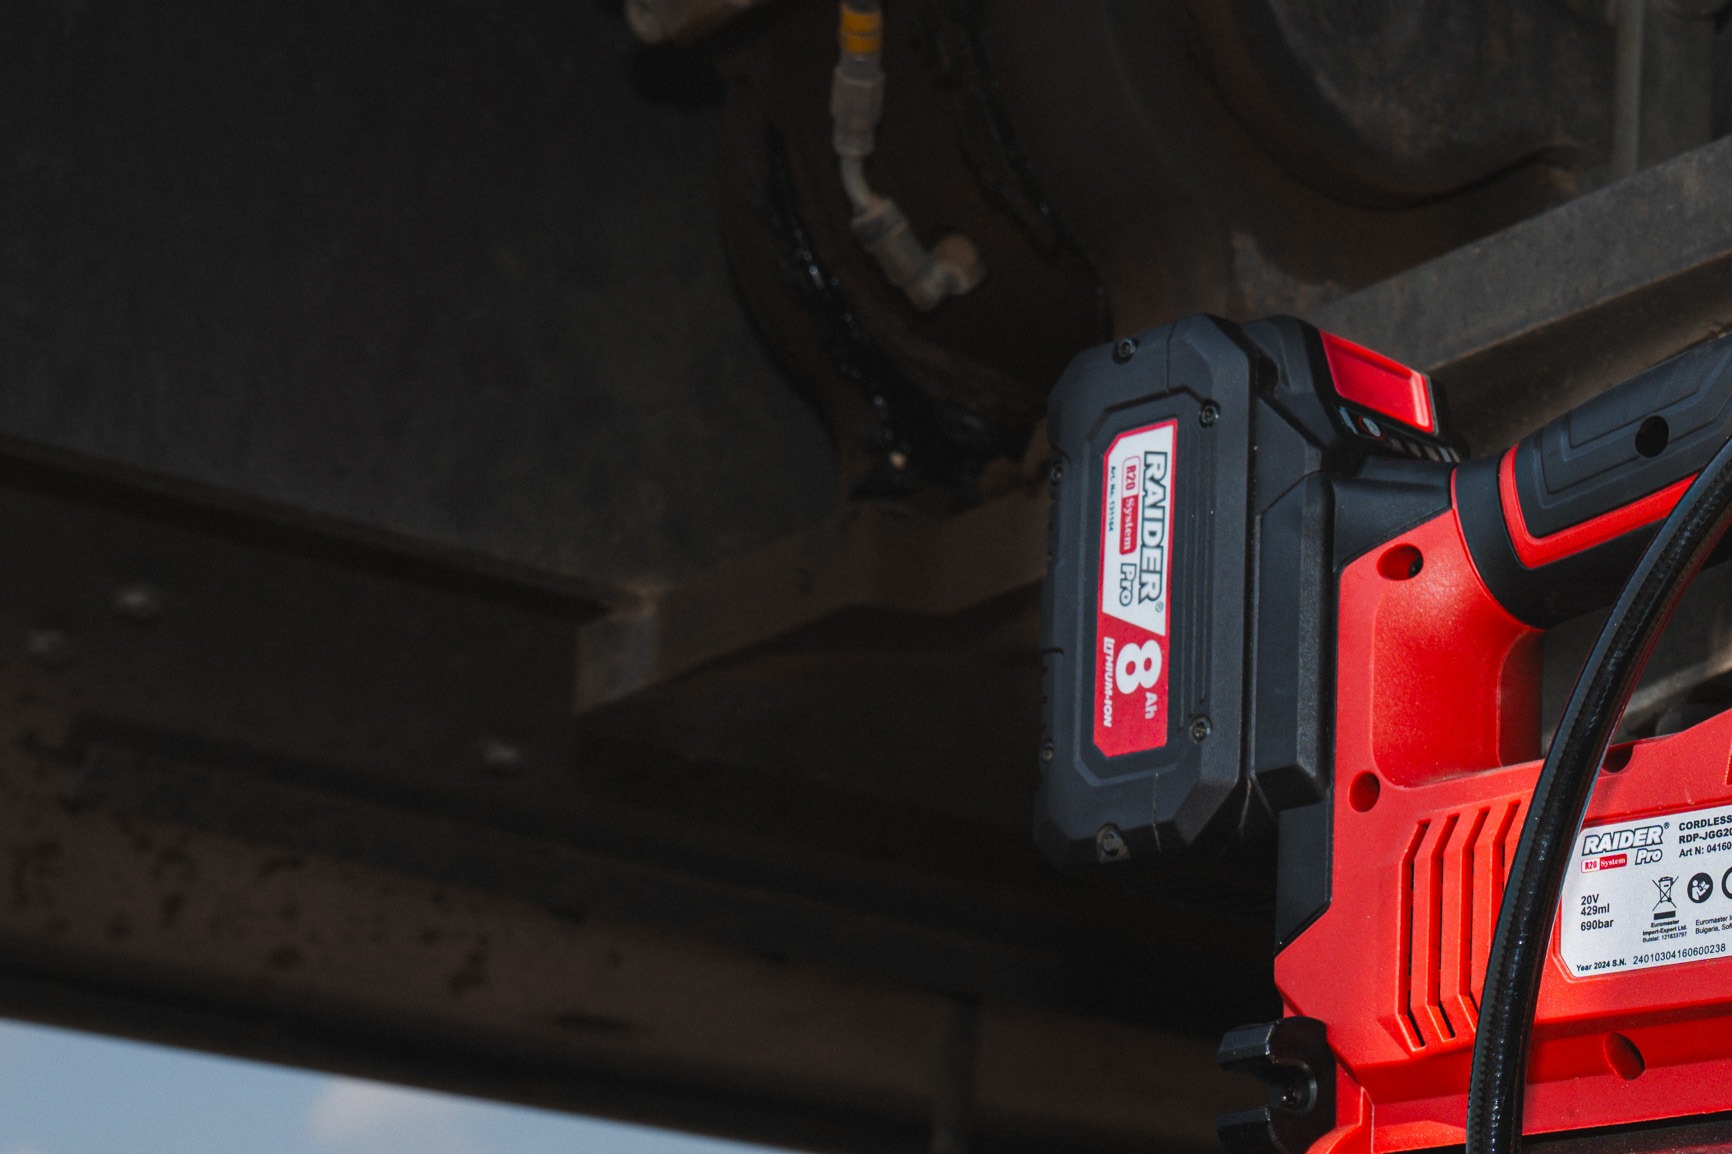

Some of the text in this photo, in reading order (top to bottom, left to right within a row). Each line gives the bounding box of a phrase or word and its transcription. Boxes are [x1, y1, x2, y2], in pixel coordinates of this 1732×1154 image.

[1123, 464, 1137, 551] R20 System
[1119, 562, 1137, 607] Pro
[1103, 636, 1115, 727] LITHIUM-ION
[1115, 639, 1163, 719] 8 Ah
[1679, 815, 1732, 831] CORDLESS
[1635, 848, 1663, 865] Pro
[1678, 847, 1693, 858] Art
[1694, 846, 1705, 856] N:
[1584, 858, 1626, 870] R20 System
[1580, 894, 1600, 906] 20V
[1580, 903, 1610, 917] 429ml
[1580, 919, 1614, 931] 690bar
[1695, 916, 1728, 925] Euromaster
[1576, 943, 1726, 972] Year 2024 S.N. 24010304160600238
